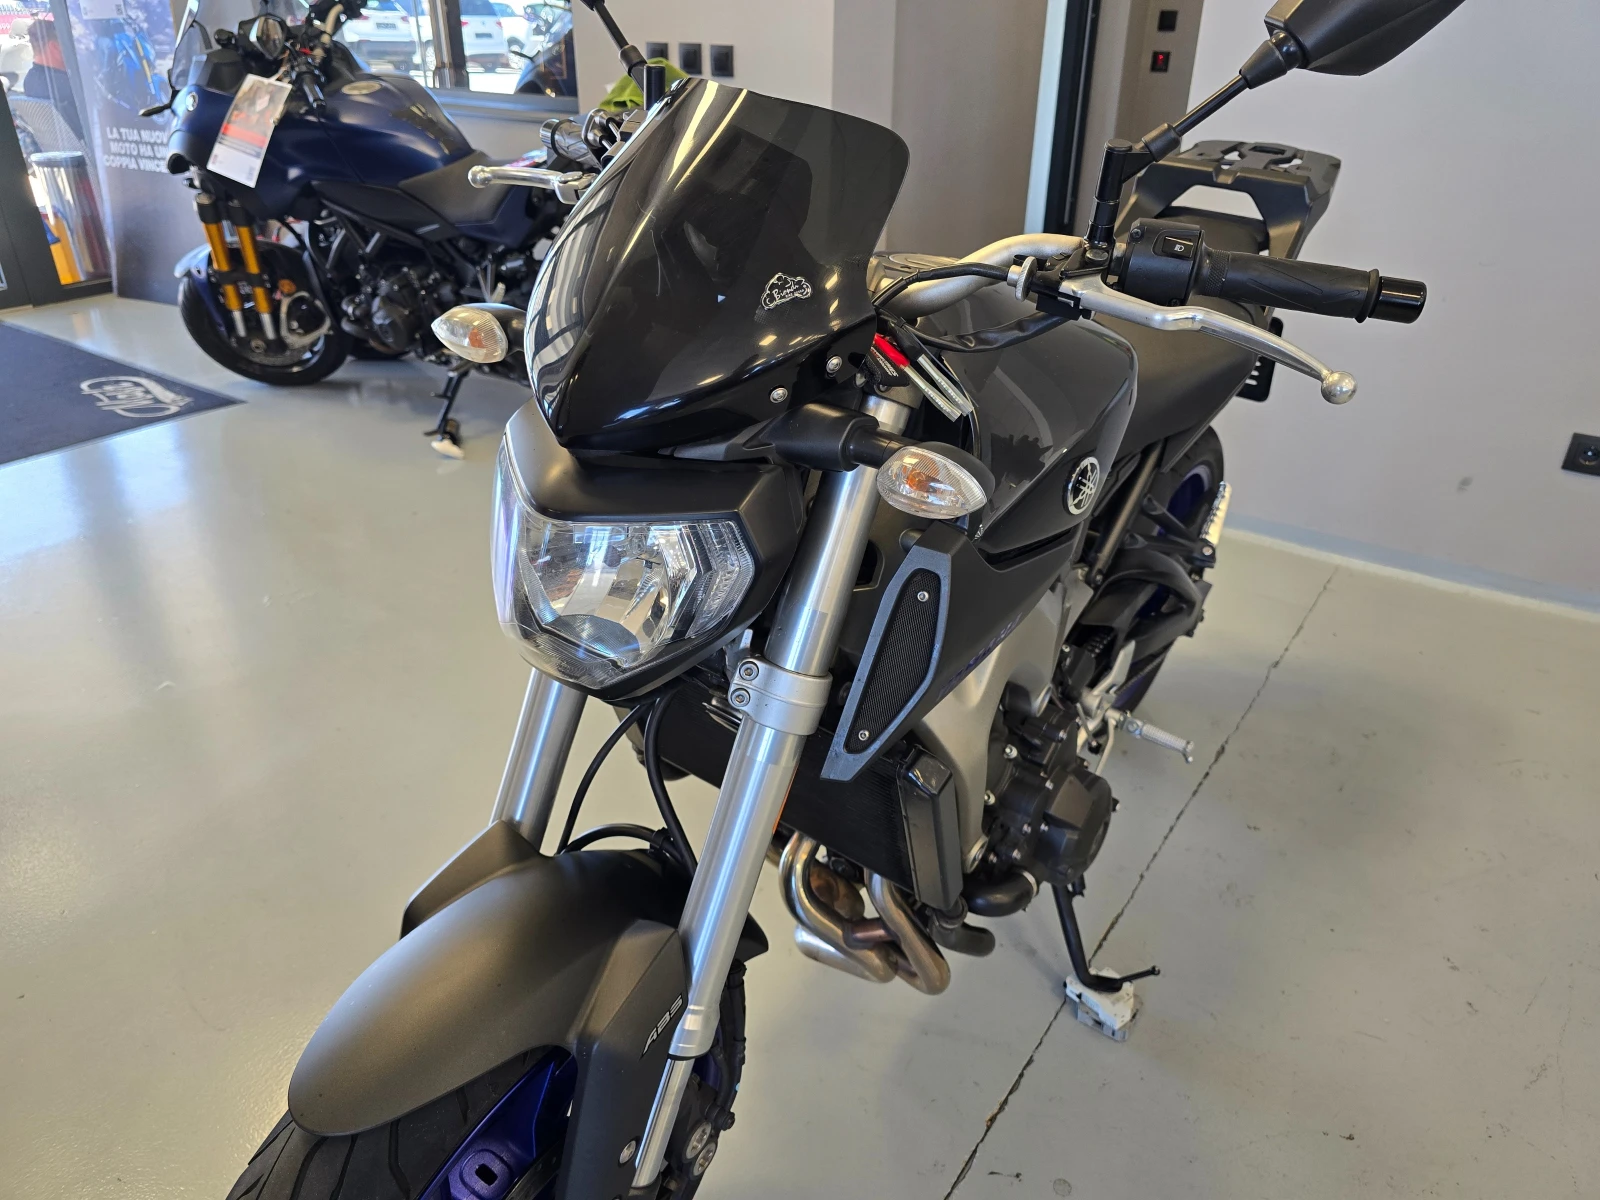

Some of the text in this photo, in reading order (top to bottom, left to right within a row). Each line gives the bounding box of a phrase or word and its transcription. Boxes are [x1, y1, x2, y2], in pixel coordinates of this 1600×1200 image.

[106, 126, 119, 140] LA
[119, 127, 140, 141] TUA
[109, 141, 138, 155] MOTO
[138, 143, 154, 157] HA
[103, 155, 138, 170] COPPIA
[642, 993, 683, 1056] ABS
